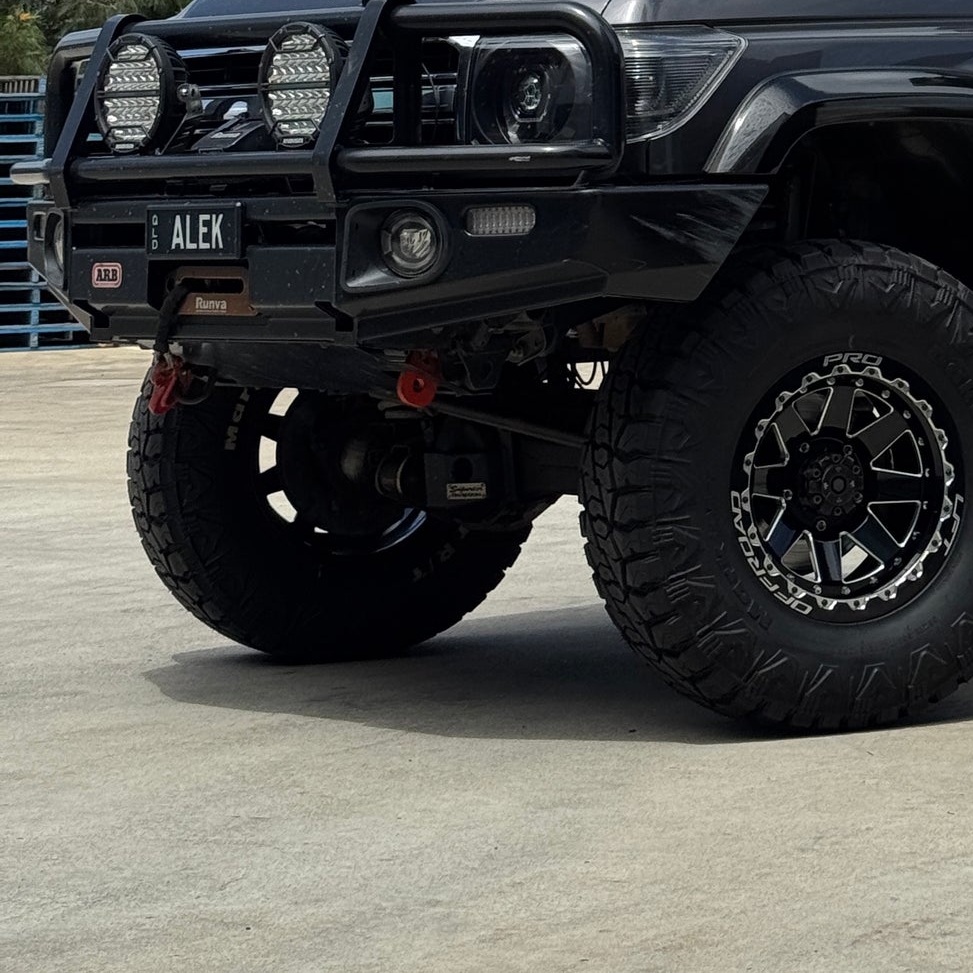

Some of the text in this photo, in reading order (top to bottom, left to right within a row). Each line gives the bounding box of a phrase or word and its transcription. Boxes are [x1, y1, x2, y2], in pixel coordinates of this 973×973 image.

[171, 213, 224, 249] ALEK
[96, 268, 118, 282] ARB
[195, 297, 227, 309] Runva
[823, 352, 883, 367] PRO
[730, 490, 813, 615] OFFROAD
